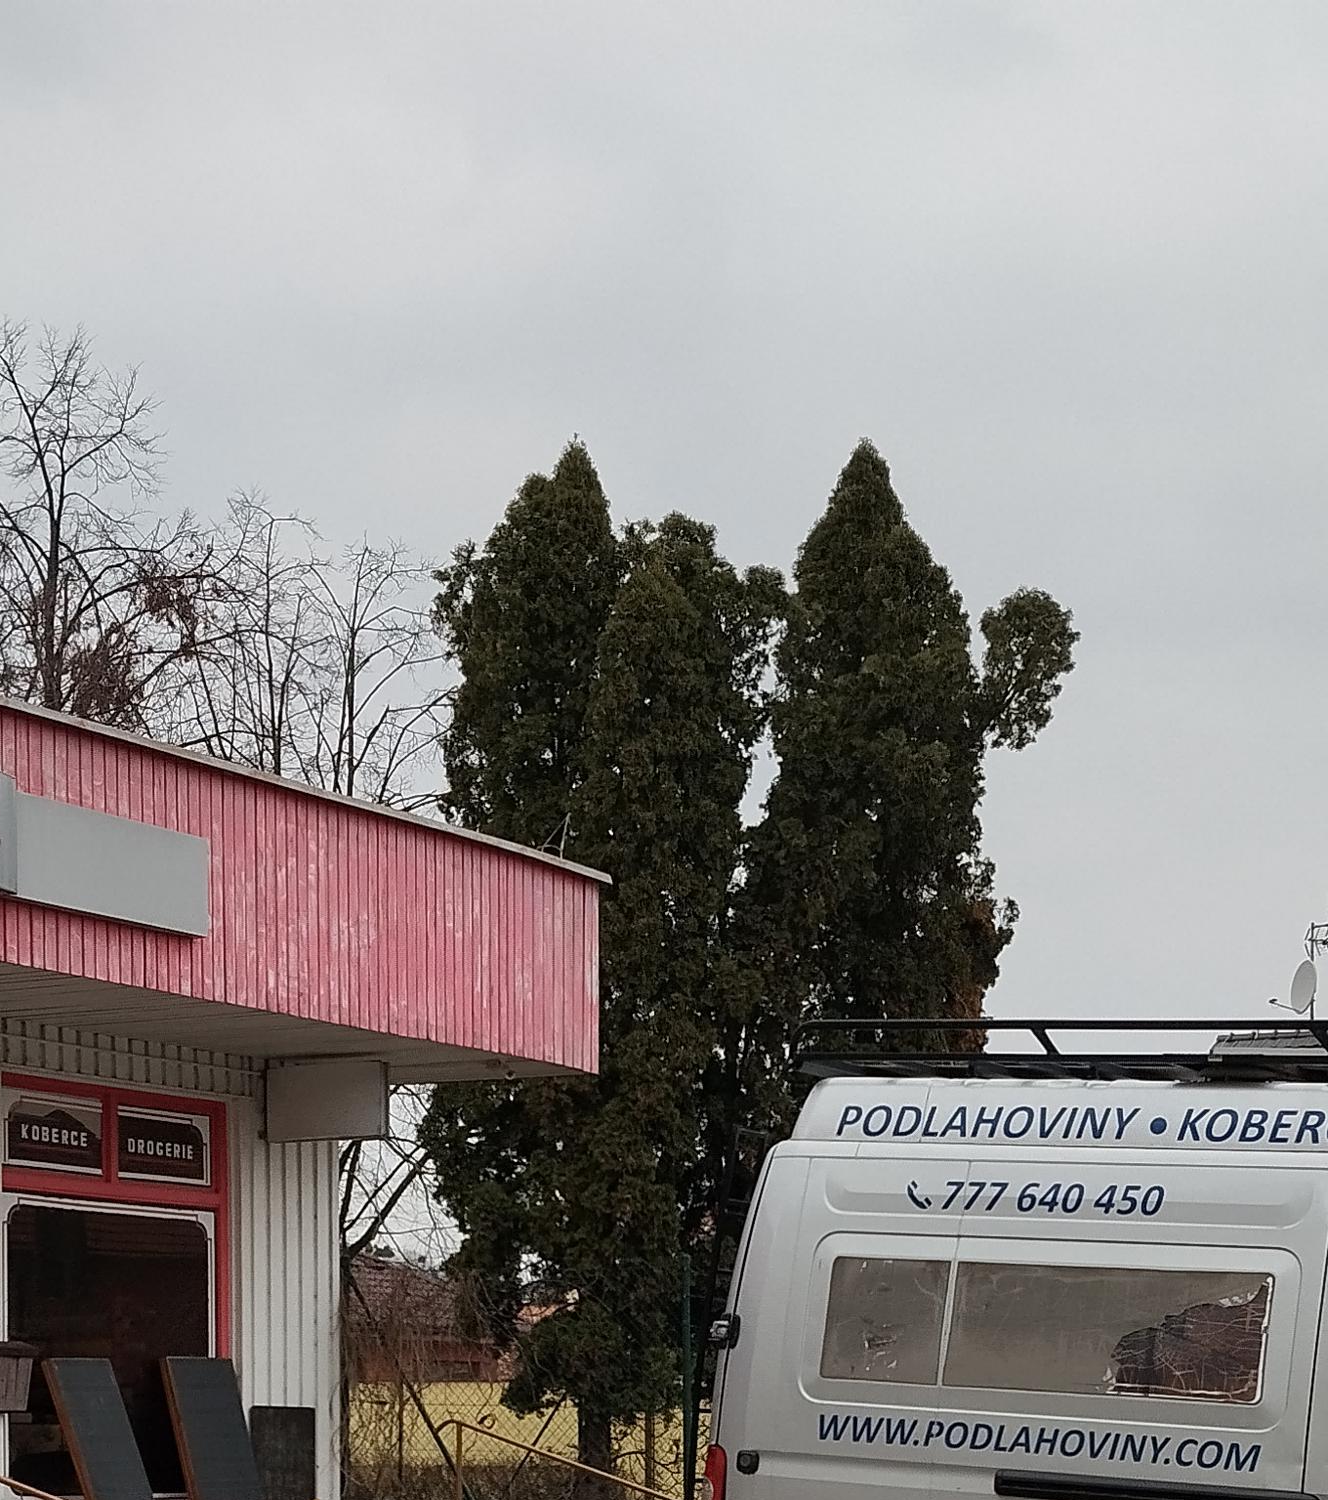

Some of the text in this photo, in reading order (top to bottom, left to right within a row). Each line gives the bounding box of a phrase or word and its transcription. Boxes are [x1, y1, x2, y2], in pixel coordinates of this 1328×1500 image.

[21, 1123, 88, 1147] KOBERCE
[835, 1104, 1140, 1140] PODLAHOVINY
[127, 1138, 194, 1160] DROGERIE
[940, 1181, 1165, 1217] 777 640 450
[818, 1414, 1261, 1473] WWW.PODLAHOVINY.COM
